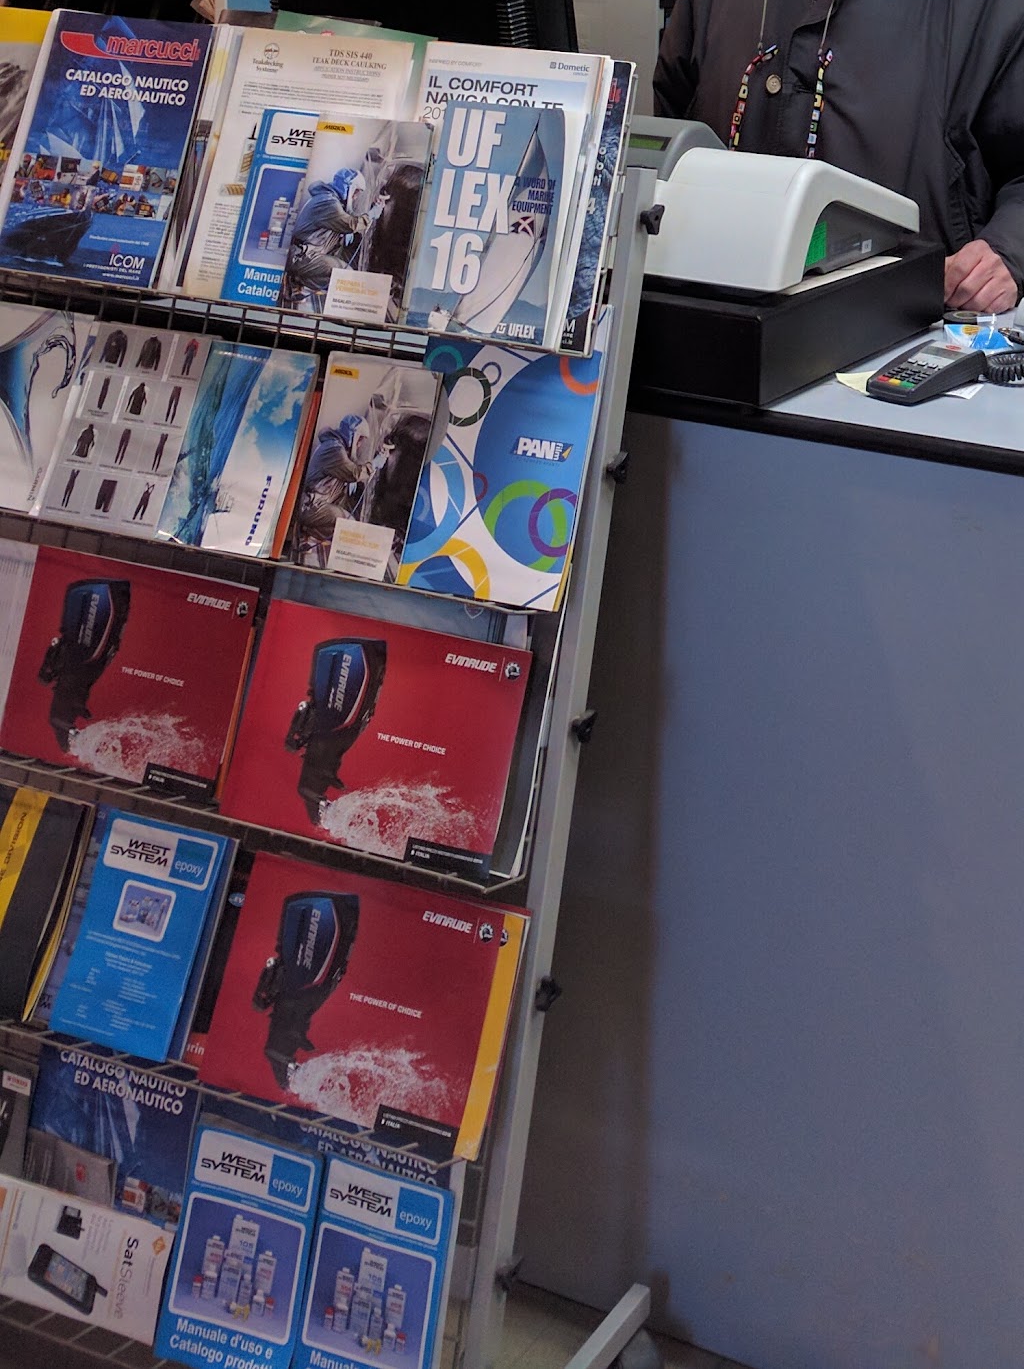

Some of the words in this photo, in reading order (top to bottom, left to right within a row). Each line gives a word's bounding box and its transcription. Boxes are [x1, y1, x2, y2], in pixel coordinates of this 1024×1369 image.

[106, 35, 197, 61] marcucci
[329, 48, 344, 57] TDS
[360, 52, 373, 60] 440
[312, 56, 329, 65] TEAK
[330, 58, 349, 67] DECK
[350, 60, 387, 70] CAULKING
[558, 62, 590, 73] Dometic
[65, 68, 132, 86] CATALOGO
[135, 76, 189, 92] NAUTICO
[428, 75, 442, 88] IL
[448, 77, 538, 97] COMFORT
[80, 84, 96, 96] ED
[99, 87, 186, 106] AERONAUTICO
[446, 107, 506, 169] UF
[434, 169, 516, 234] LEX
[528, 190, 554, 203] MARINE
[512, 201, 553, 216] EQUIPMENT
[109, 253, 145, 270] ICOM
[430, 232, 484, 295] 16
[508, 322, 535, 340] UFLEX
[517, 437, 555, 460] PAN
[245, 475, 272, 546] FURUNO
[187, 593, 232, 611] EVINRUDE
[445, 653, 497, 673] EVINRUDE
[122, 666, 133, 675] THE
[133, 669, 154, 680] POWER
[155, 674, 163, 682] OF
[163, 675, 184, 687] CHOICE
[335, 654, 352, 712] EVINRUDE
[377, 733, 390, 742] THE
[391, 736, 413, 747] POWER
[414, 741, 422, 749] OF
[423, 743, 446, 755] CHOICE
[4, 811, 27, 866] DIVISION
[128, 839, 171, 856] WEST
[110, 845, 168, 867] SYSTEM
[175, 860, 203, 877] epoxy
[423, 911, 473, 933] EVINRUDE
[350, 993, 363, 1003] THE
[364, 995, 387, 1008] POWER
[388, 1002, 397, 1010] OF
[397, 1005, 422, 1019] CHOICE
[74, 1070, 89, 1085] ED
[92, 1076, 183, 1115] AERONAUTICO
[201, 1158, 265, 1184] SYSTEM
[222, 1151, 267, 1172] WEST
[272, 1178, 303, 1197] epoxy
[348, 1183, 392, 1204] WEST
[330, 1188, 392, 1217] SYSTEM
[400, 1211, 432, 1229] epoxy
[114, 1236, 139, 1319] SatSleeve
[177, 1318, 228, 1344] Manuale
[230, 1333, 261, 1357] d'uso
[265, 1348, 273, 1360] e
[169, 1335, 223, 1366] Catalogo
